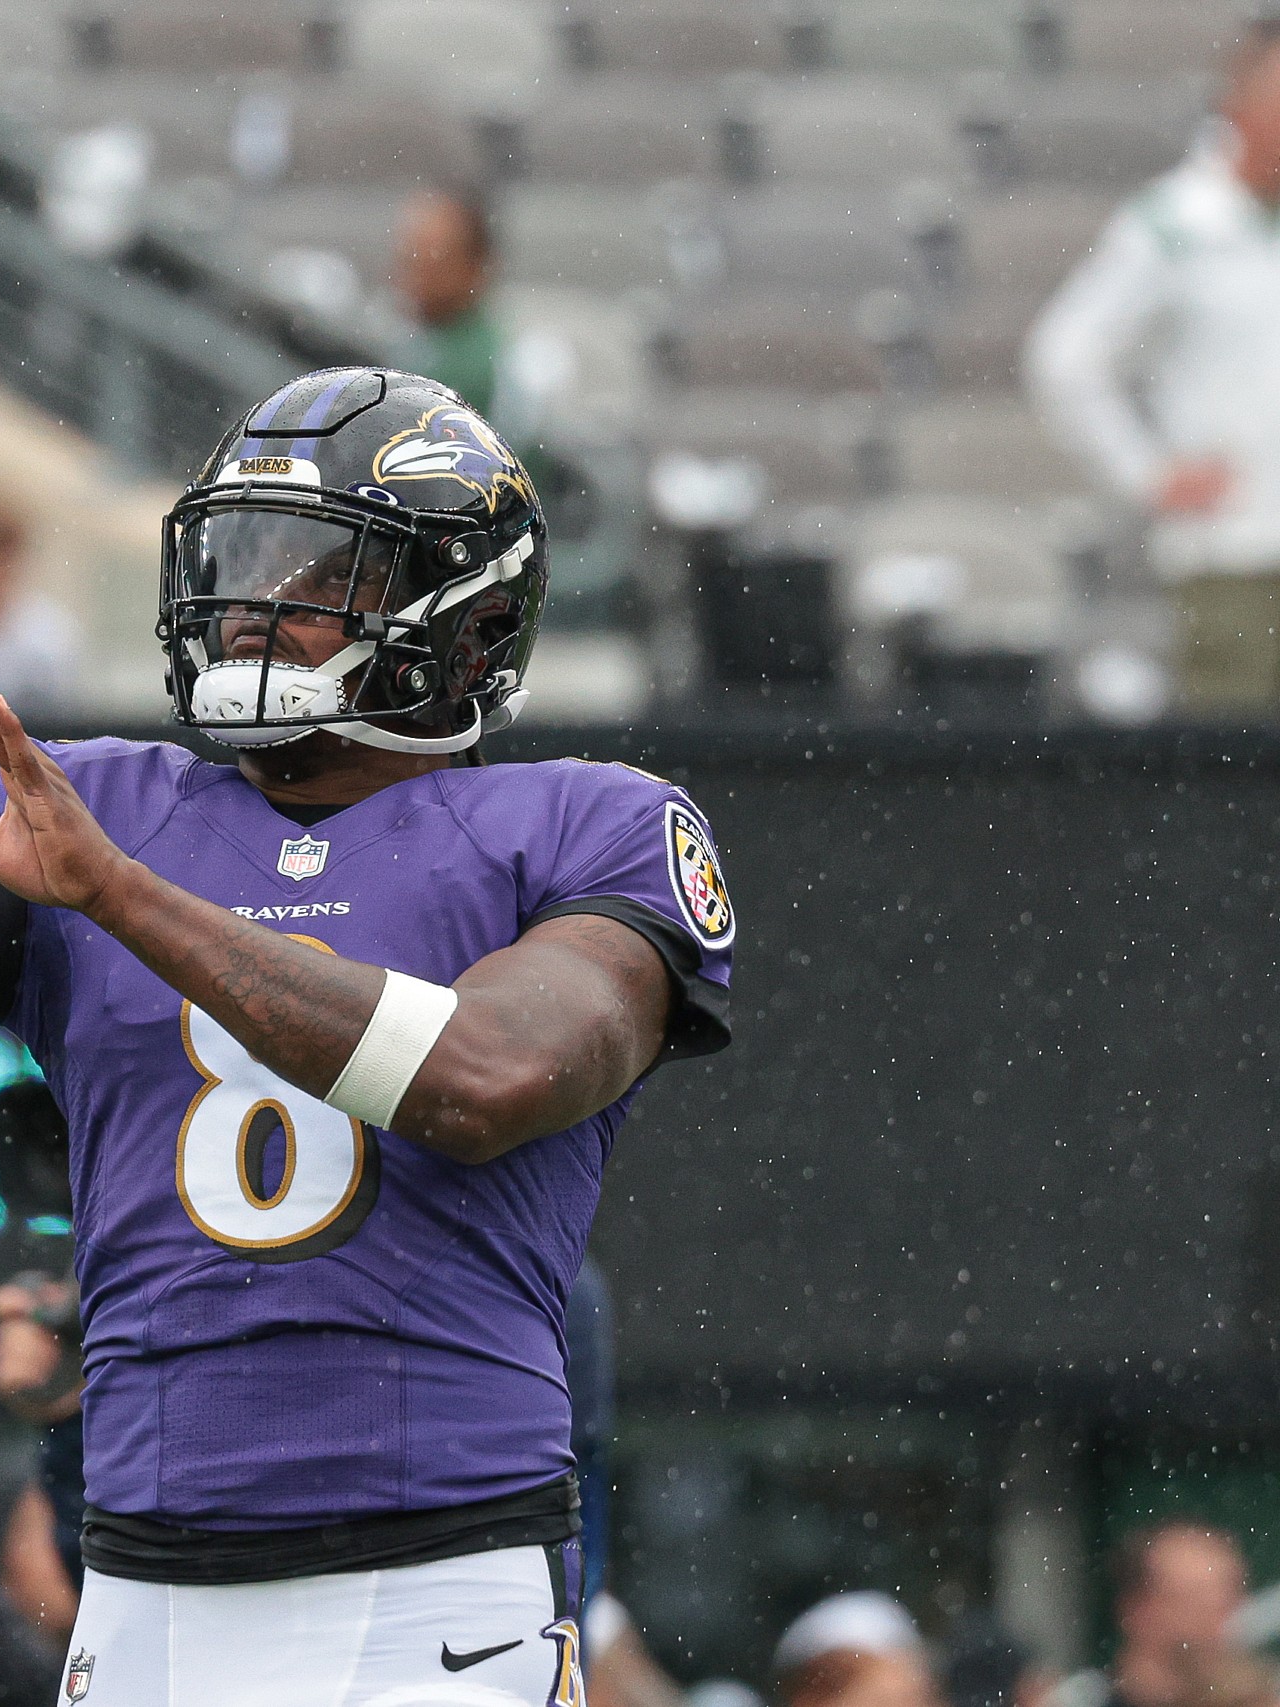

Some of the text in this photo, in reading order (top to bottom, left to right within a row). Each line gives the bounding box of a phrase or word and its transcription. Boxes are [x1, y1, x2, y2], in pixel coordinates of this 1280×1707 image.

[238, 458, 293, 474] RAVENS
[286, 855, 316, 873] NFL
[230, 901, 351, 921] RAVENS
[175, 933, 381, 1264] 8
